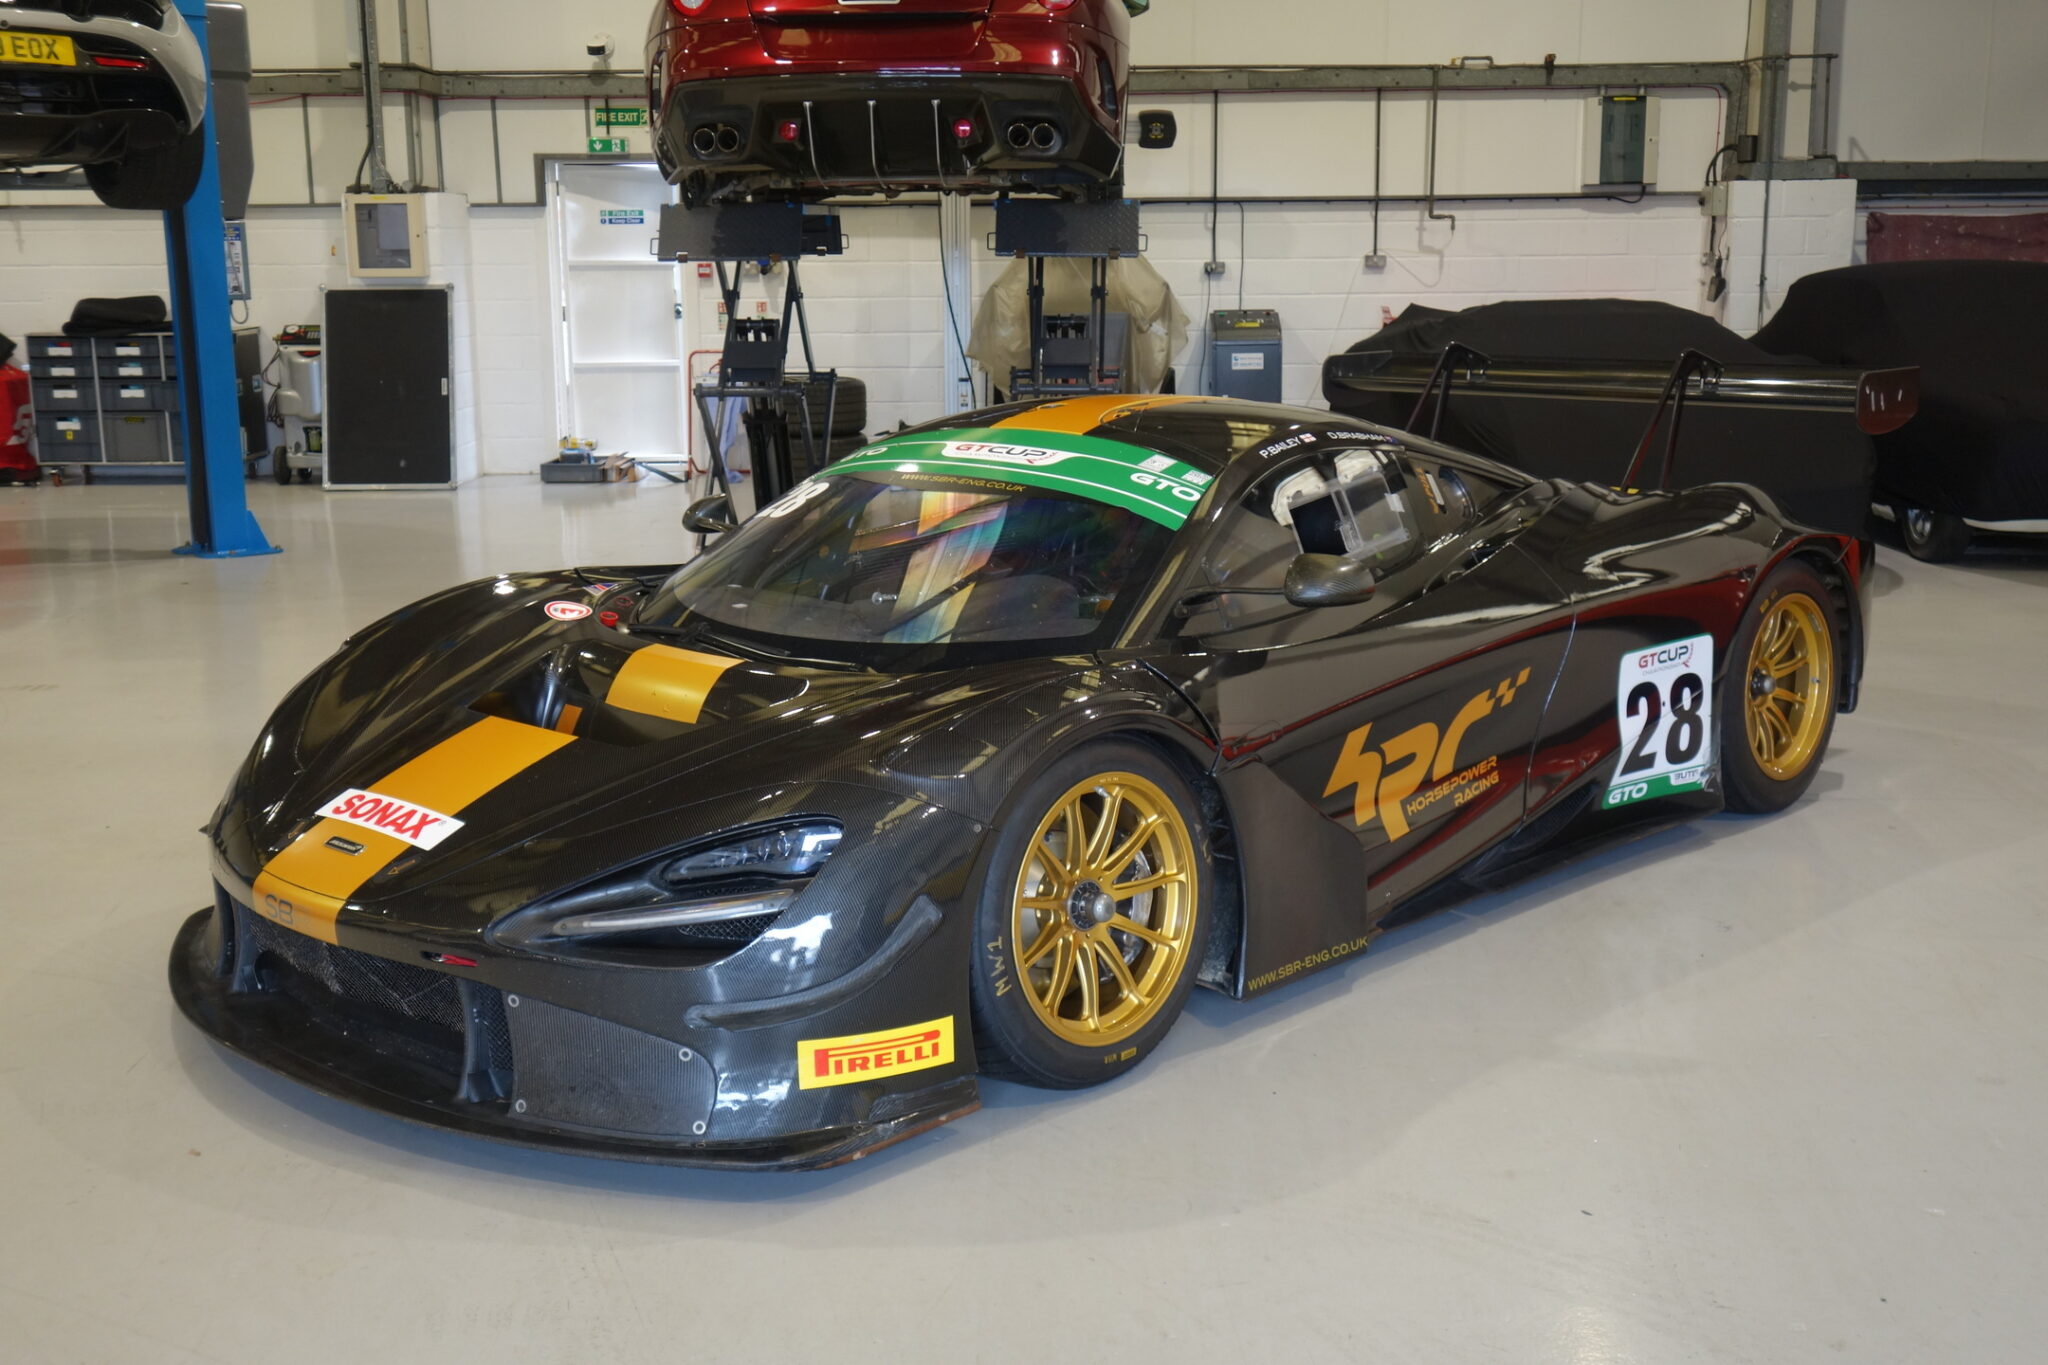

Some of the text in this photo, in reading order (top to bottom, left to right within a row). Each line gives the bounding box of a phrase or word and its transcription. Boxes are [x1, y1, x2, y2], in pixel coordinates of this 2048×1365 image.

[618, 112, 639, 122] EXIT
[1259, 436, 1302, 459] P.BAILEY
[1130, 472, 1202, 502] GTO
[1619, 672, 1704, 777] 28
[1407, 755, 1498, 816] HORSEPOWER
[1454, 770, 1500, 807] RACING
[1608, 783, 1648, 804] GTO
[332, 794, 442, 840] SONAX
[1248, 936, 1369, 991] WWW.SBR-ENG.CO.UK
[814, 1029, 941, 1078] PIRELLI
